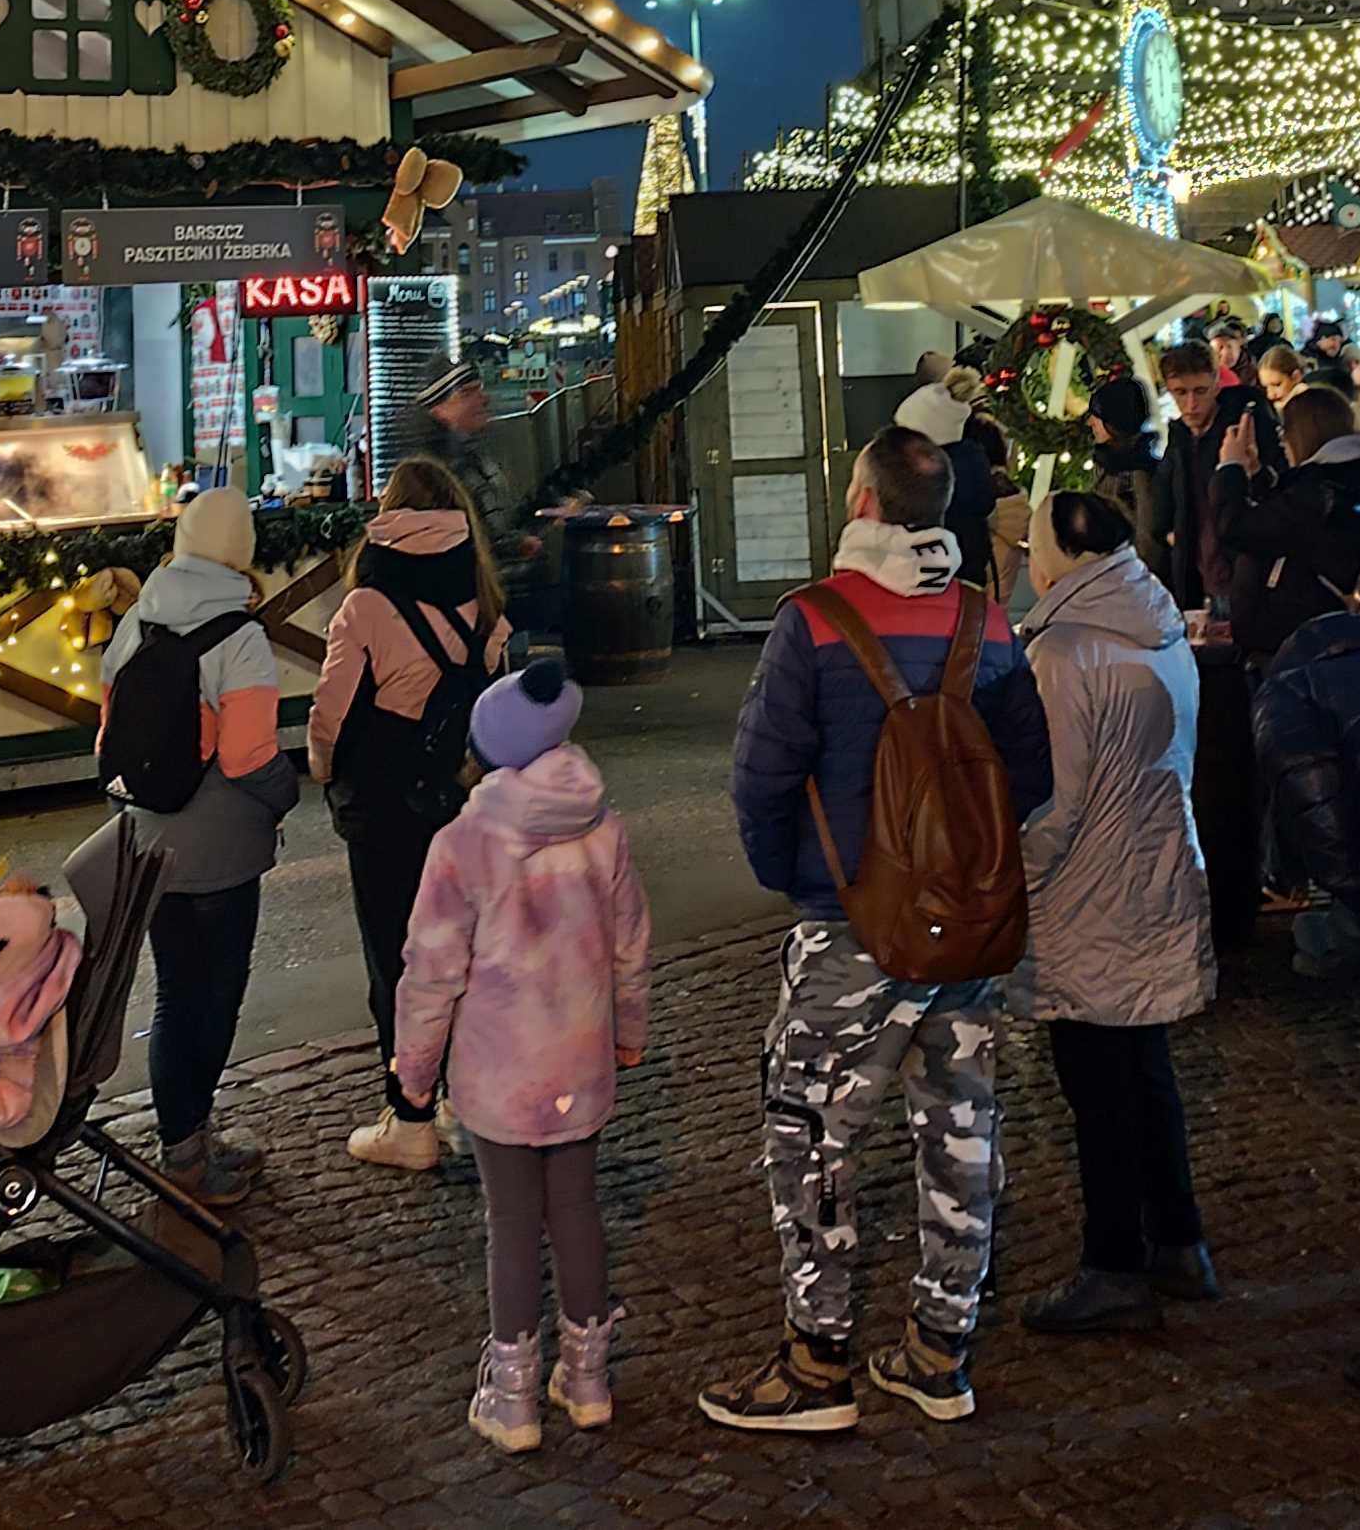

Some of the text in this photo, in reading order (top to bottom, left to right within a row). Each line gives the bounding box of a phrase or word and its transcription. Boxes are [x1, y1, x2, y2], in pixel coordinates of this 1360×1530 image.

[174, 224, 244, 241] BARSZCZ
[124, 242, 292, 263] PASZTECIKI I ŻEBERKA
[245, 275, 352, 308] KASA
[387, 284, 426, 307] Menu
